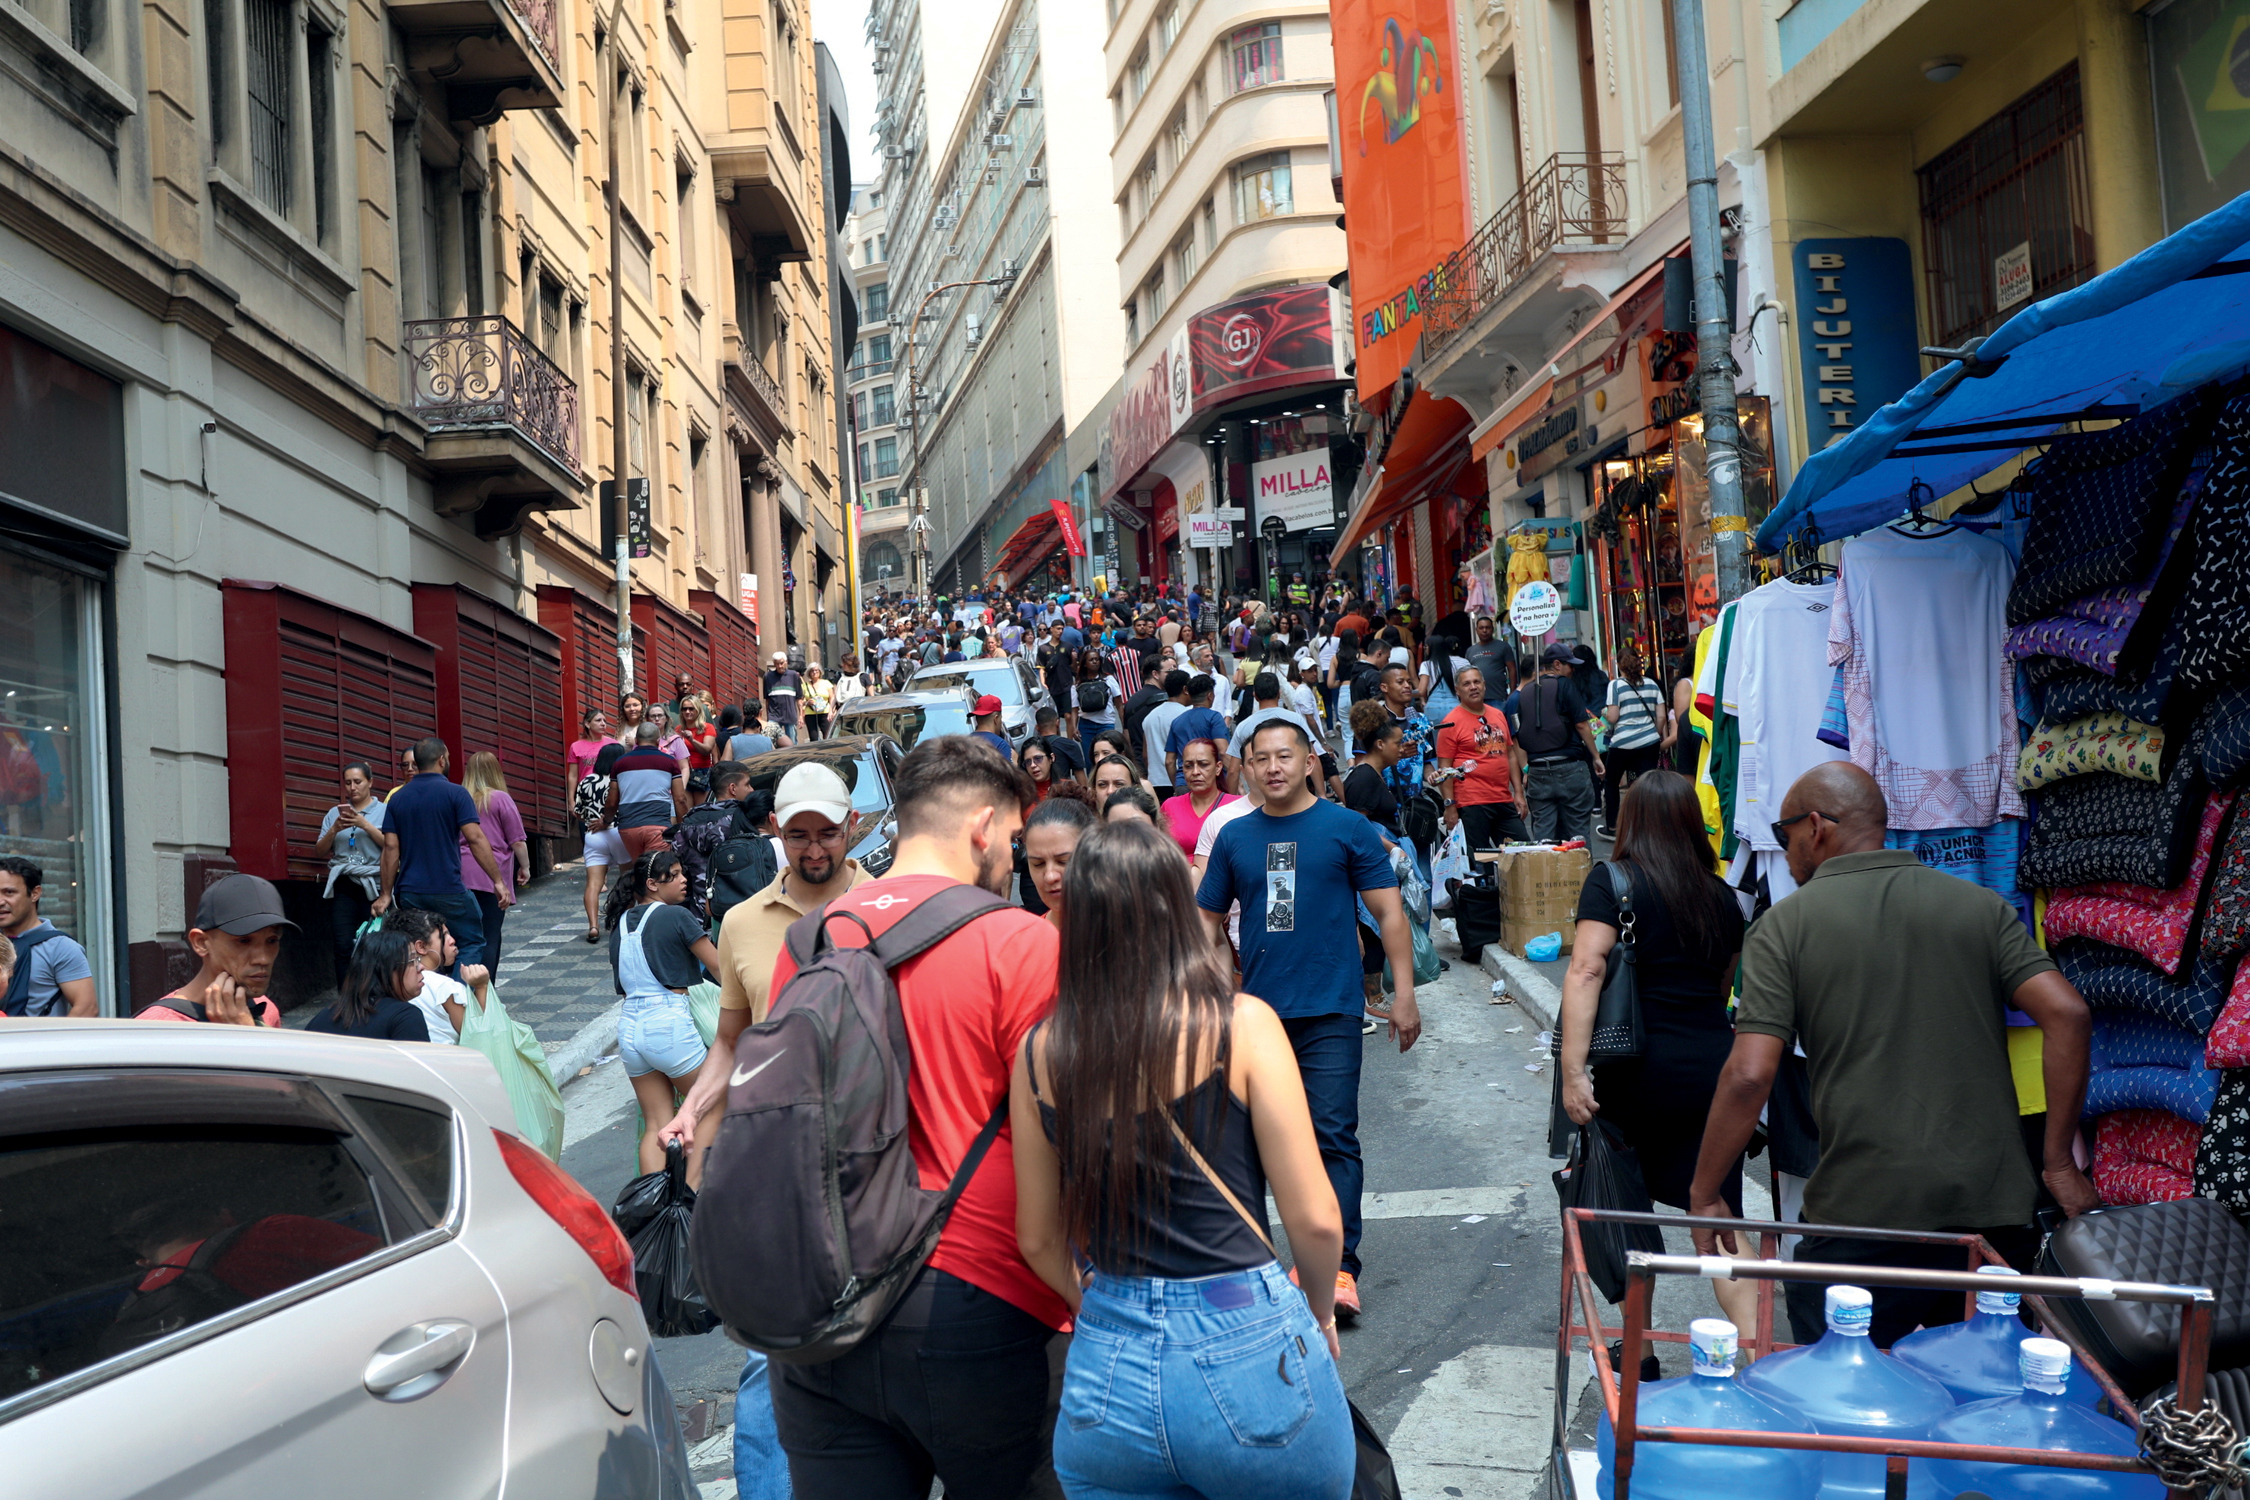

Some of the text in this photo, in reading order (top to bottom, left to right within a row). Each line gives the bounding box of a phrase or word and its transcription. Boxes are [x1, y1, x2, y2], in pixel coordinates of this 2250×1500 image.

[1999, 263, 2028, 288] ALUGA
[1228, 328, 1251, 352] GJ
[1260, 464, 1331, 497] MILLA
[1338, 511, 1347, 519] 85
[1192, 521, 1230, 533] MILLA
[1236, 531, 1245, 539] 85
[1517, 602, 1556, 613] Personaliza
[1533, 612, 1550, 620] hora
[1941, 835, 1985, 850] UNHCR
[1944, 847, 1987, 863] ACNUR
